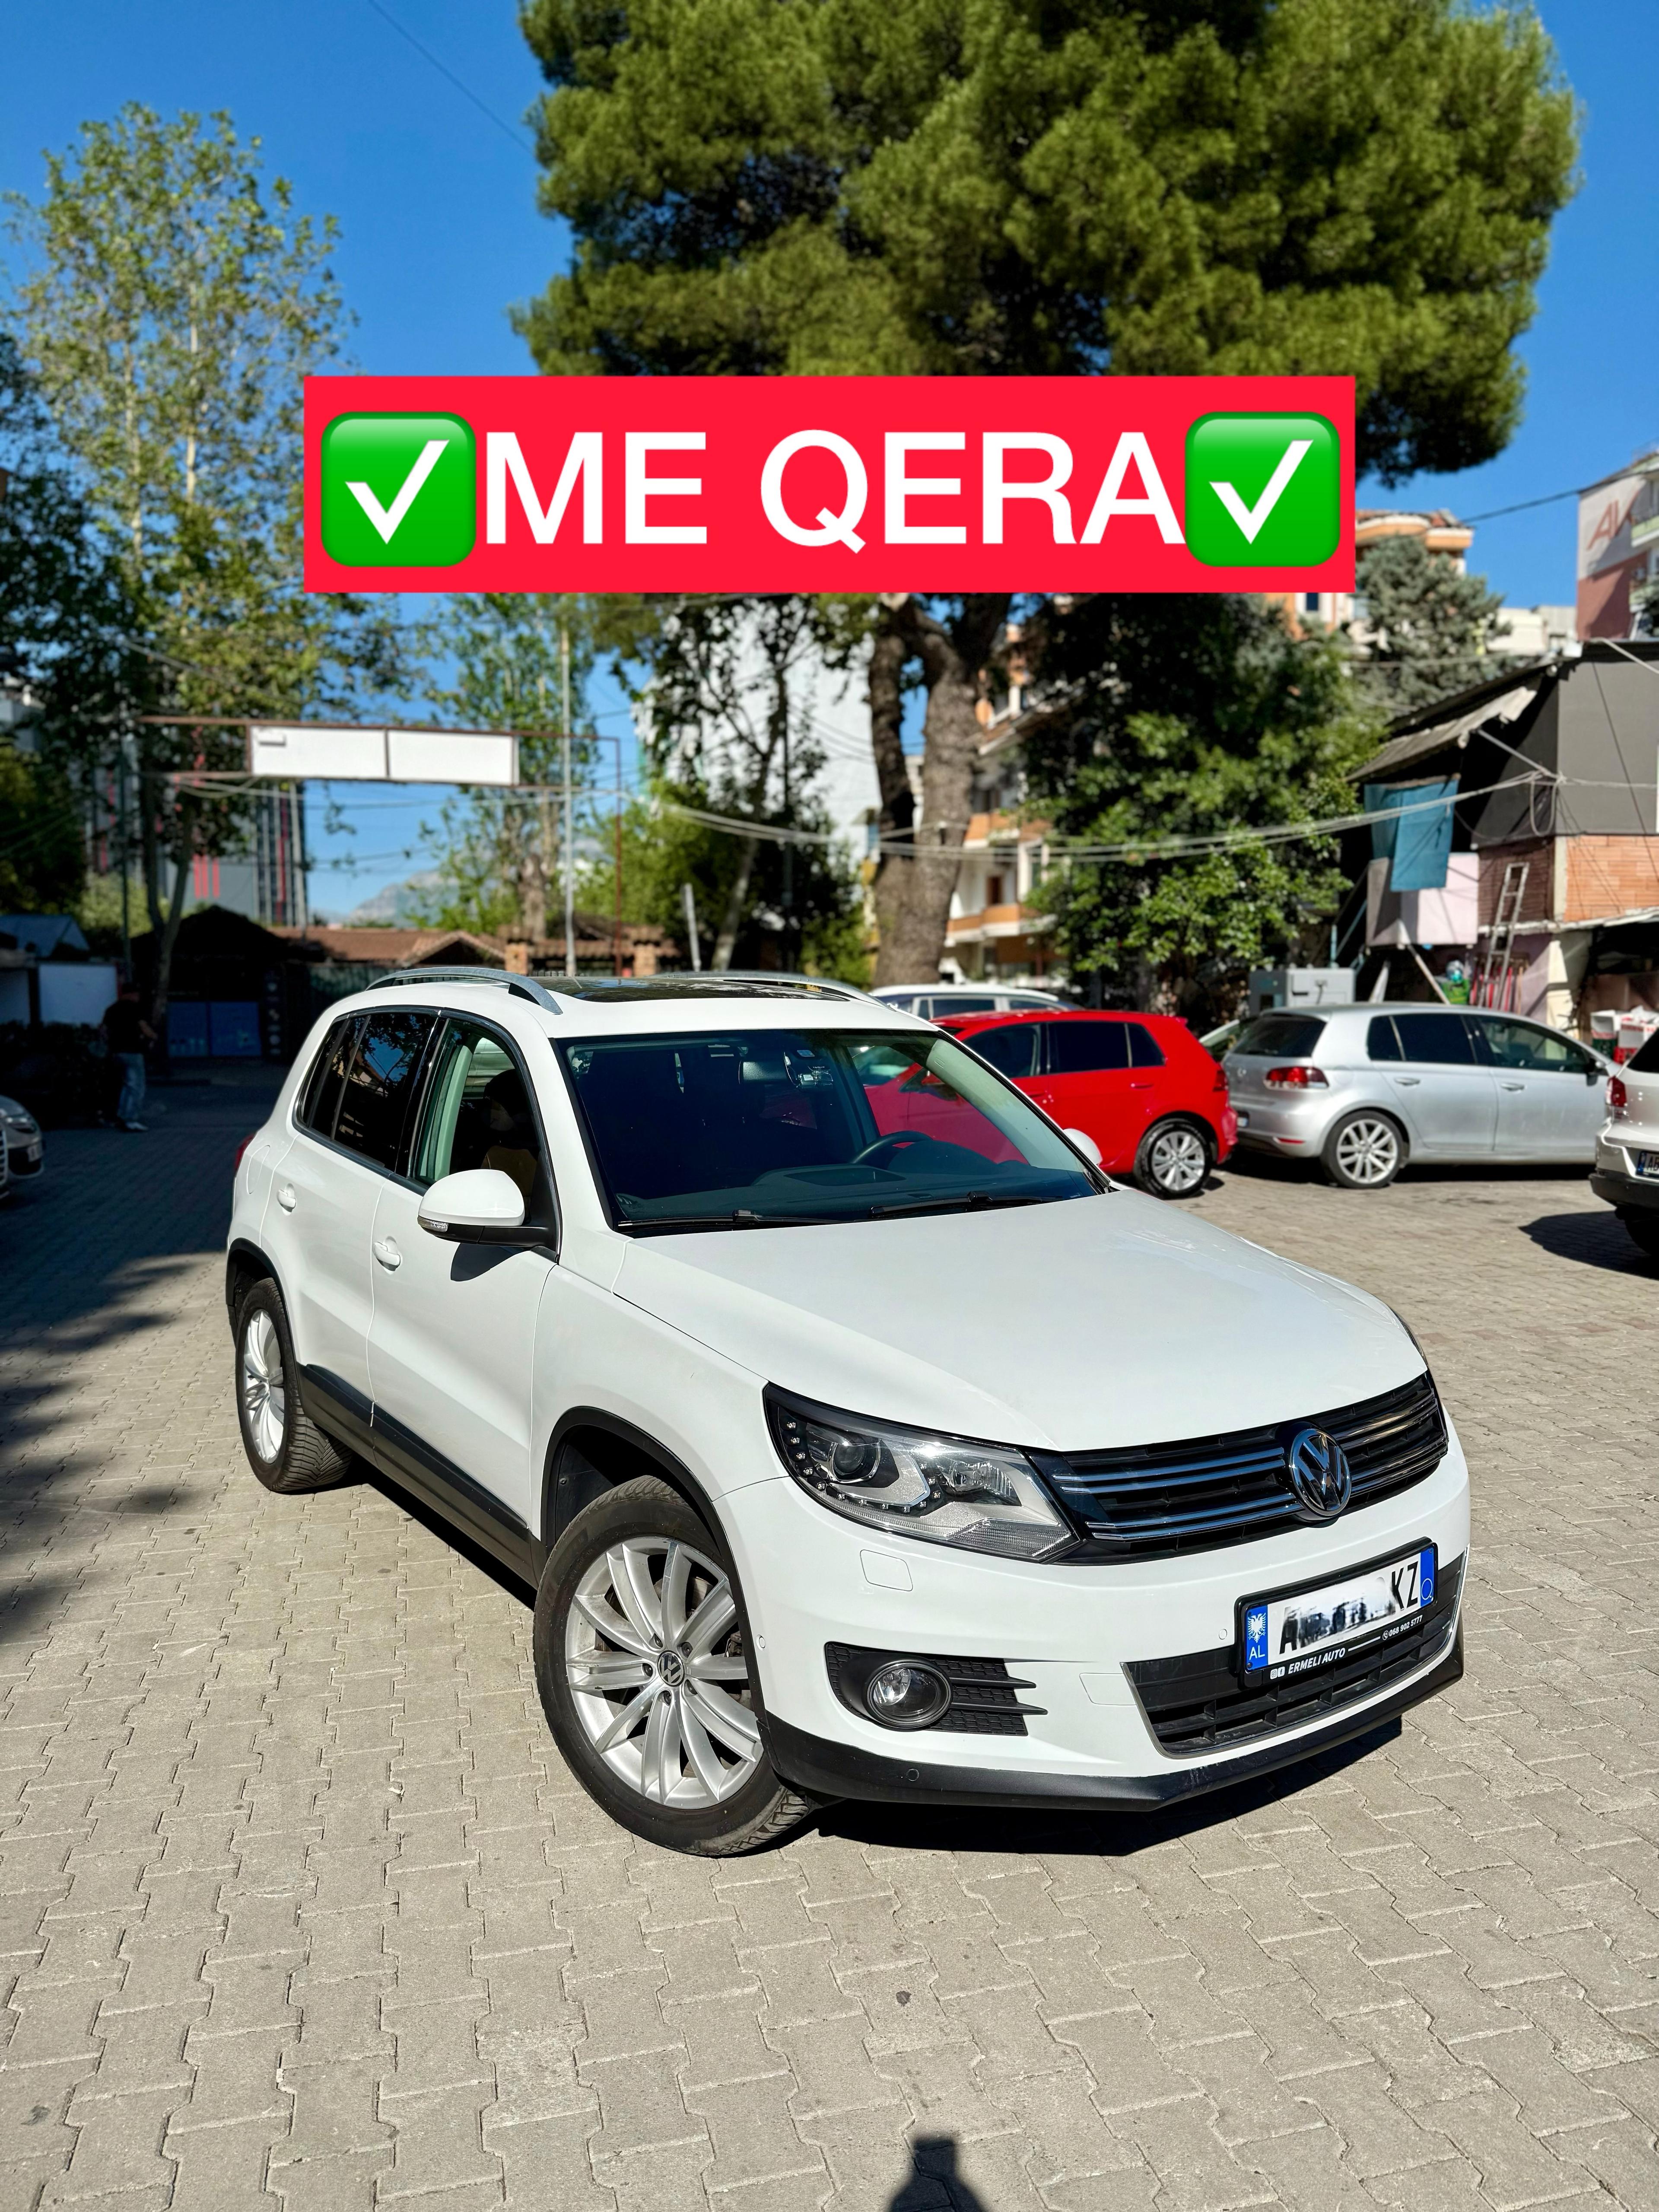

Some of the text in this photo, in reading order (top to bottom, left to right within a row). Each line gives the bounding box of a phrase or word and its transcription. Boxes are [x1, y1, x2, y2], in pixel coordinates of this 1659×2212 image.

[1391, 1560, 1419, 1611] KZ
[1389, 1615, 1423, 1637] 068 902 5777
[1249, 1645, 1265, 1660] AL
[1288, 1647, 1345, 1675] ERMELI AUTO
